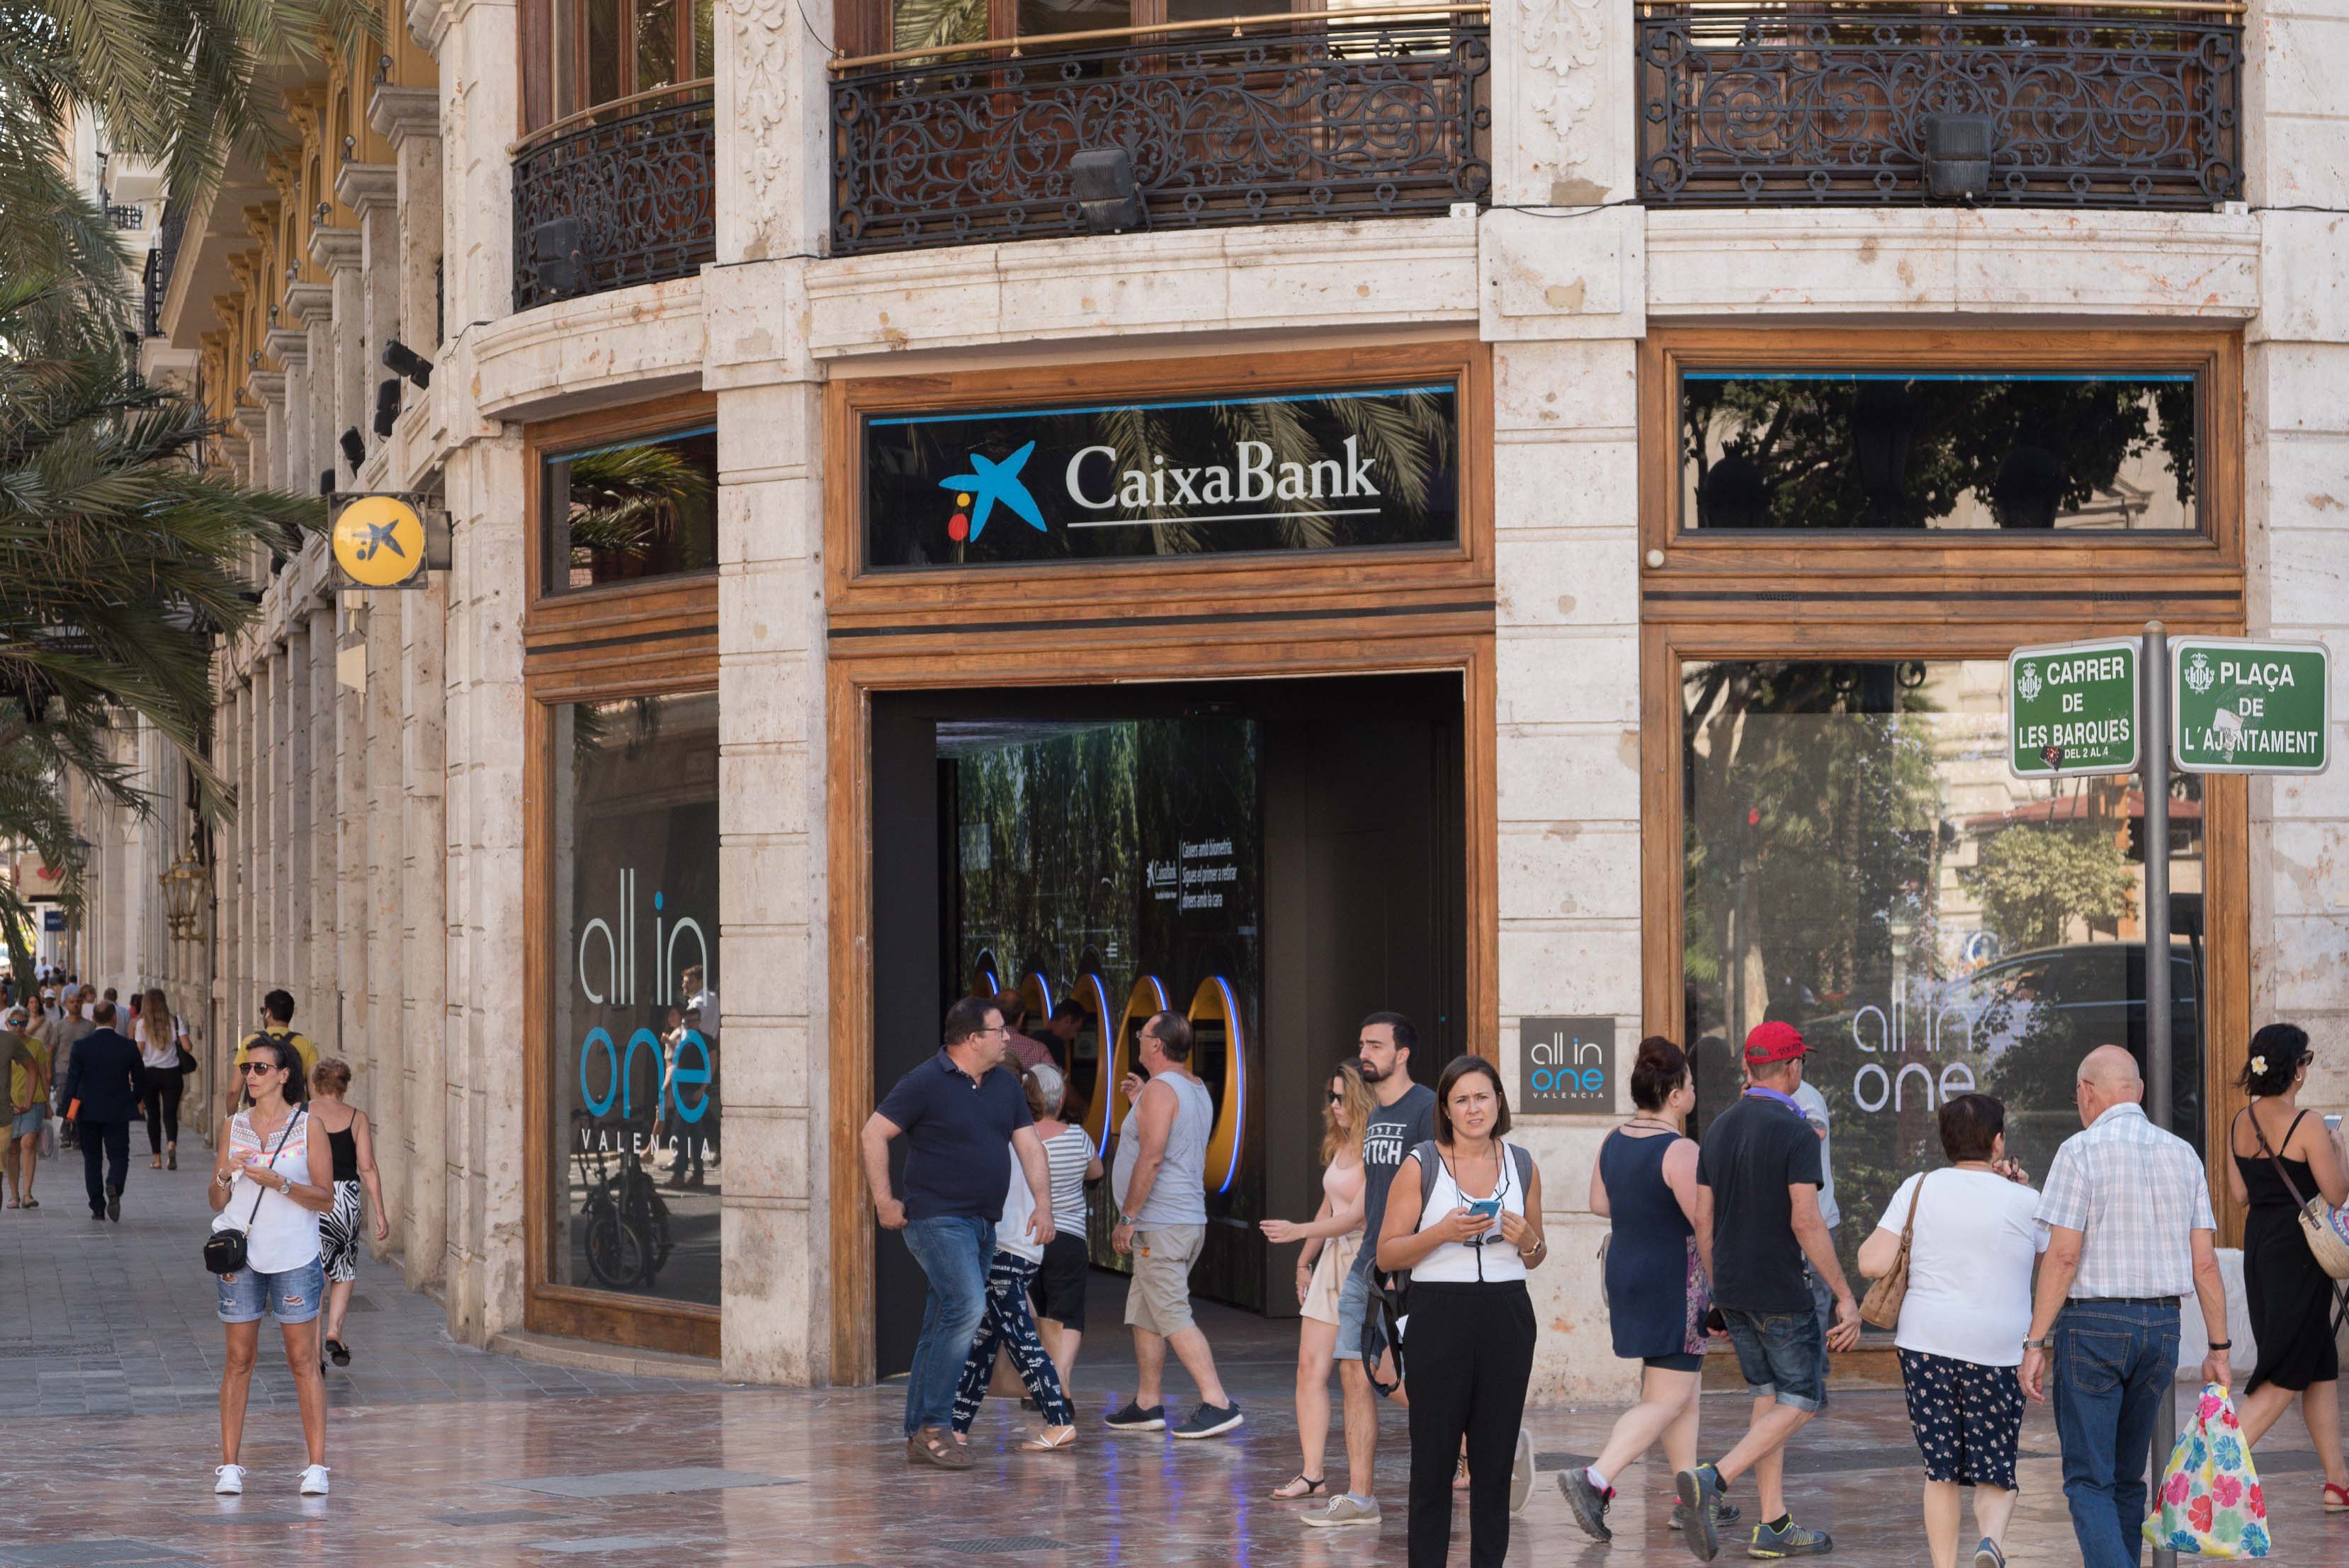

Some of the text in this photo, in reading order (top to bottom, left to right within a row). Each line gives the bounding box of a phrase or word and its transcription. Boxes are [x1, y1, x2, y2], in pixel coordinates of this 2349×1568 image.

[1065, 434, 1381, 509] CaixaBank
[2047, 656, 2124, 686] CARRER
[2220, 662, 2295, 692] PLAÇA
[2062, 693, 2083, 713] DE
[2238, 698, 2264, 717] DE
[2019, 718, 2130, 749] LES BARQUES
[2064, 746, 2109, 759] DEL 2 AL 4
[579, 868, 707, 1006] all in
[1853, 979, 1906, 1052] all
[1531, 1032, 1602, 1065] all in
[580, 1026, 711, 1123] one
[1531, 1068, 1604, 1091] one
[1854, 1062, 1975, 1113] one
[582, 1128, 710, 1159] VALENCIA
